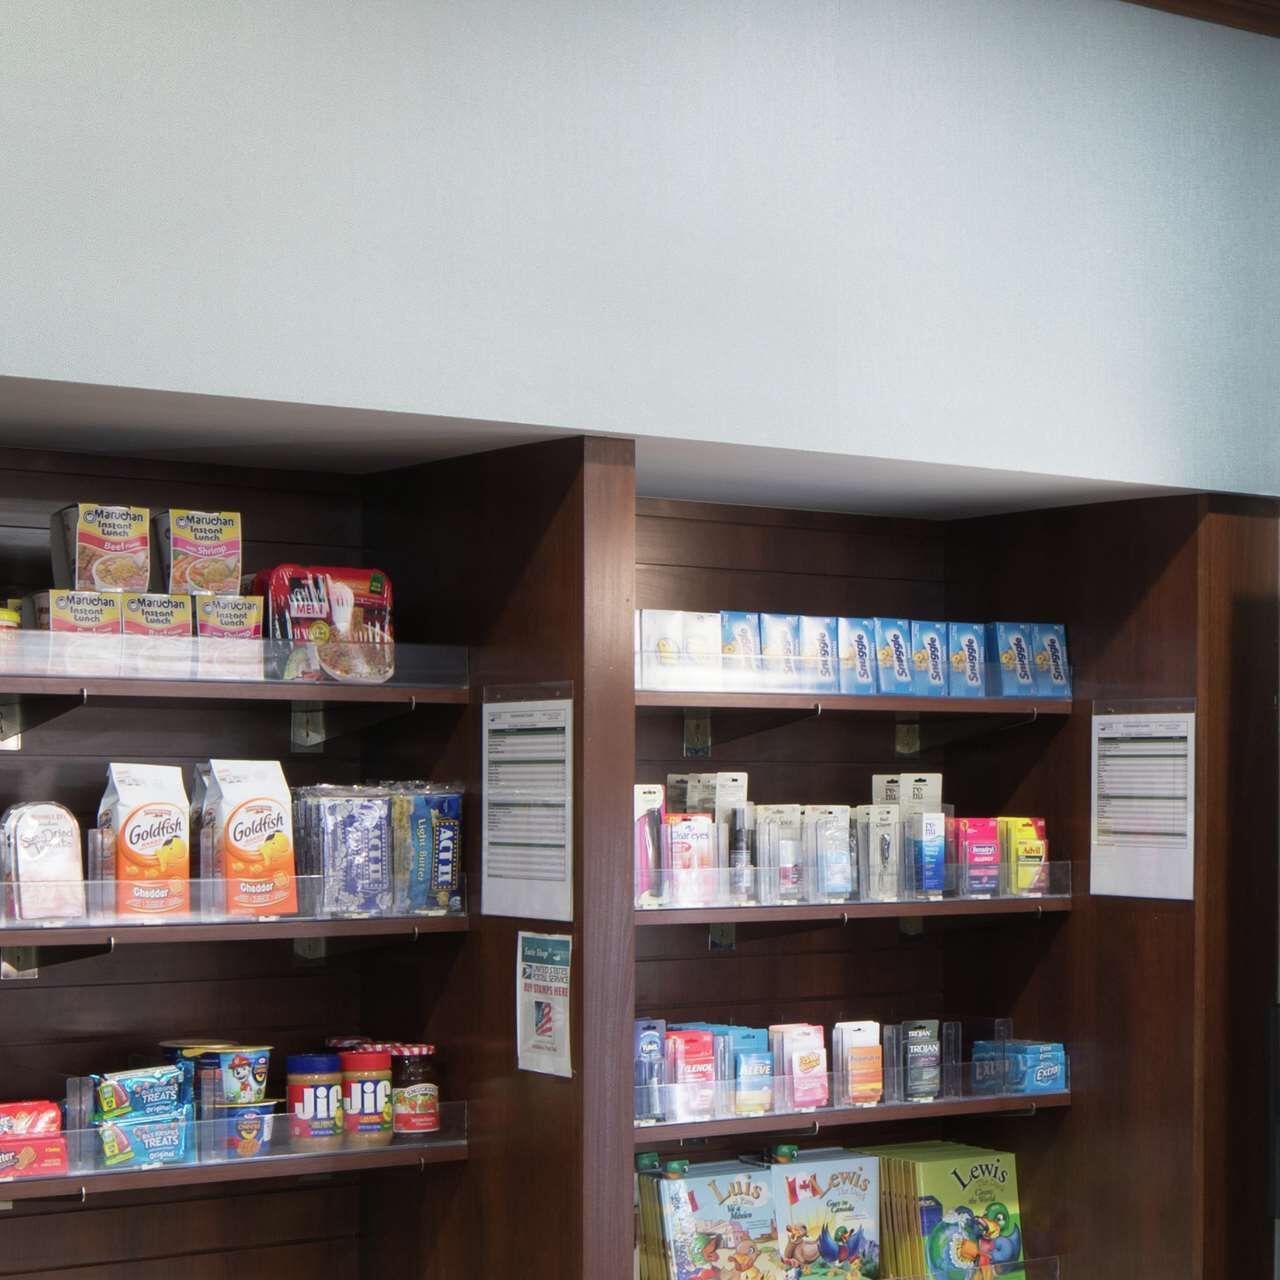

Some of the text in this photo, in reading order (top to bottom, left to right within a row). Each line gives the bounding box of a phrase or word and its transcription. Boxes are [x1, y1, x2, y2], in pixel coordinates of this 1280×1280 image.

[96, 510, 144, 522] Maruchan
[186, 515, 234, 526] Maruchan
[98, 521, 132, 529] Instant
[190, 526, 223, 534] Instant
[101, 529, 128, 537] Lunch
[104, 542, 124, 550] Beef
[198, 545, 226, 554] Shrimp
[66, 596, 115, 608] Maruchan
[138, 598, 185, 609] Maruchan
[211, 601, 258, 611] Maruchan
[70, 607, 103, 615] Instant
[141, 609, 174, 617] Instant
[857, 633, 871, 680] Snuggle
[890, 632, 909, 680] Snuggle
[928, 636, 942, 682] Snuggle
[967, 637, 980, 683] Snuggle
[1014, 636, 1031, 682] Snuggle
[1049, 637, 1065, 682] Snuggle
[129, 818, 182, 845] Goldfish
[232, 813, 284, 842] Goldfish
[1024, 847, 1041, 855] Advil
[550, 975, 569, 984] SERVICE
[533, 984, 568, 997] STAMPS HERE
[909, 1045, 939, 1054] TROJAN
[742, 1065, 772, 1075] ALEVE
[1036, 1066, 1059, 1081] Extra
[143, 1091, 177, 1103] TREATS
[295, 1085, 343, 1119] Jif
[344, 1080, 391, 1114] Jif
[144, 1136, 179, 1149] TREATS
[149, 1151, 175, 1160] Original
[951, 1158, 1009, 1192] Lewis
[809, 1165, 871, 1199] Lewis
[707, 1175, 762, 1206] Luis
